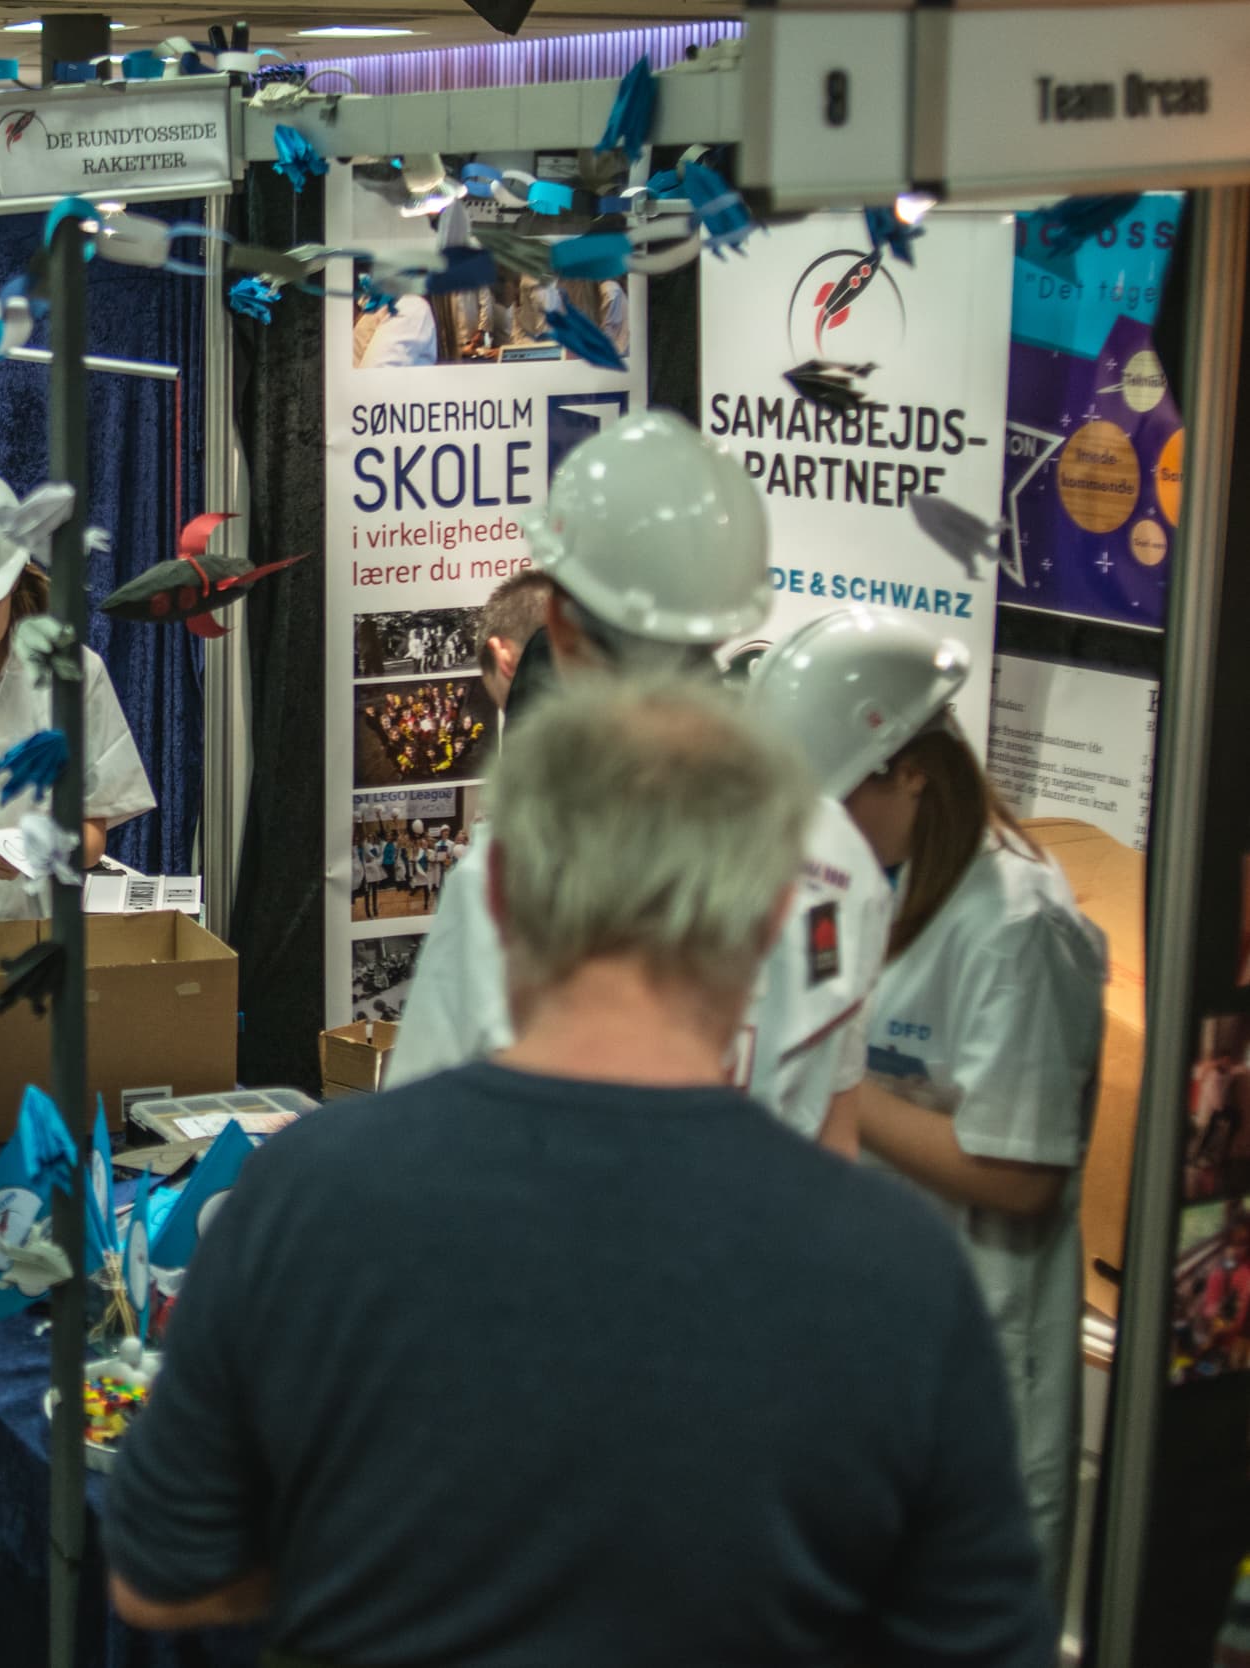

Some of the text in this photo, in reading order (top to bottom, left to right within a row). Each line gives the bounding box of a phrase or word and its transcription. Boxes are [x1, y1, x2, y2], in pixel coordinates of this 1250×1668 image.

[1037, 76, 1116, 123] Team
[46, 122, 217, 151] DE RUNDTOSSEDE
[82, 152, 187, 175] RAKETTER
[351, 397, 533, 437] SØNDERHOLM
[353, 440, 532, 513] SKOLE
[352, 525, 358, 550] i
[352, 561, 422, 587] lærer
[430, 556, 461, 582] du
